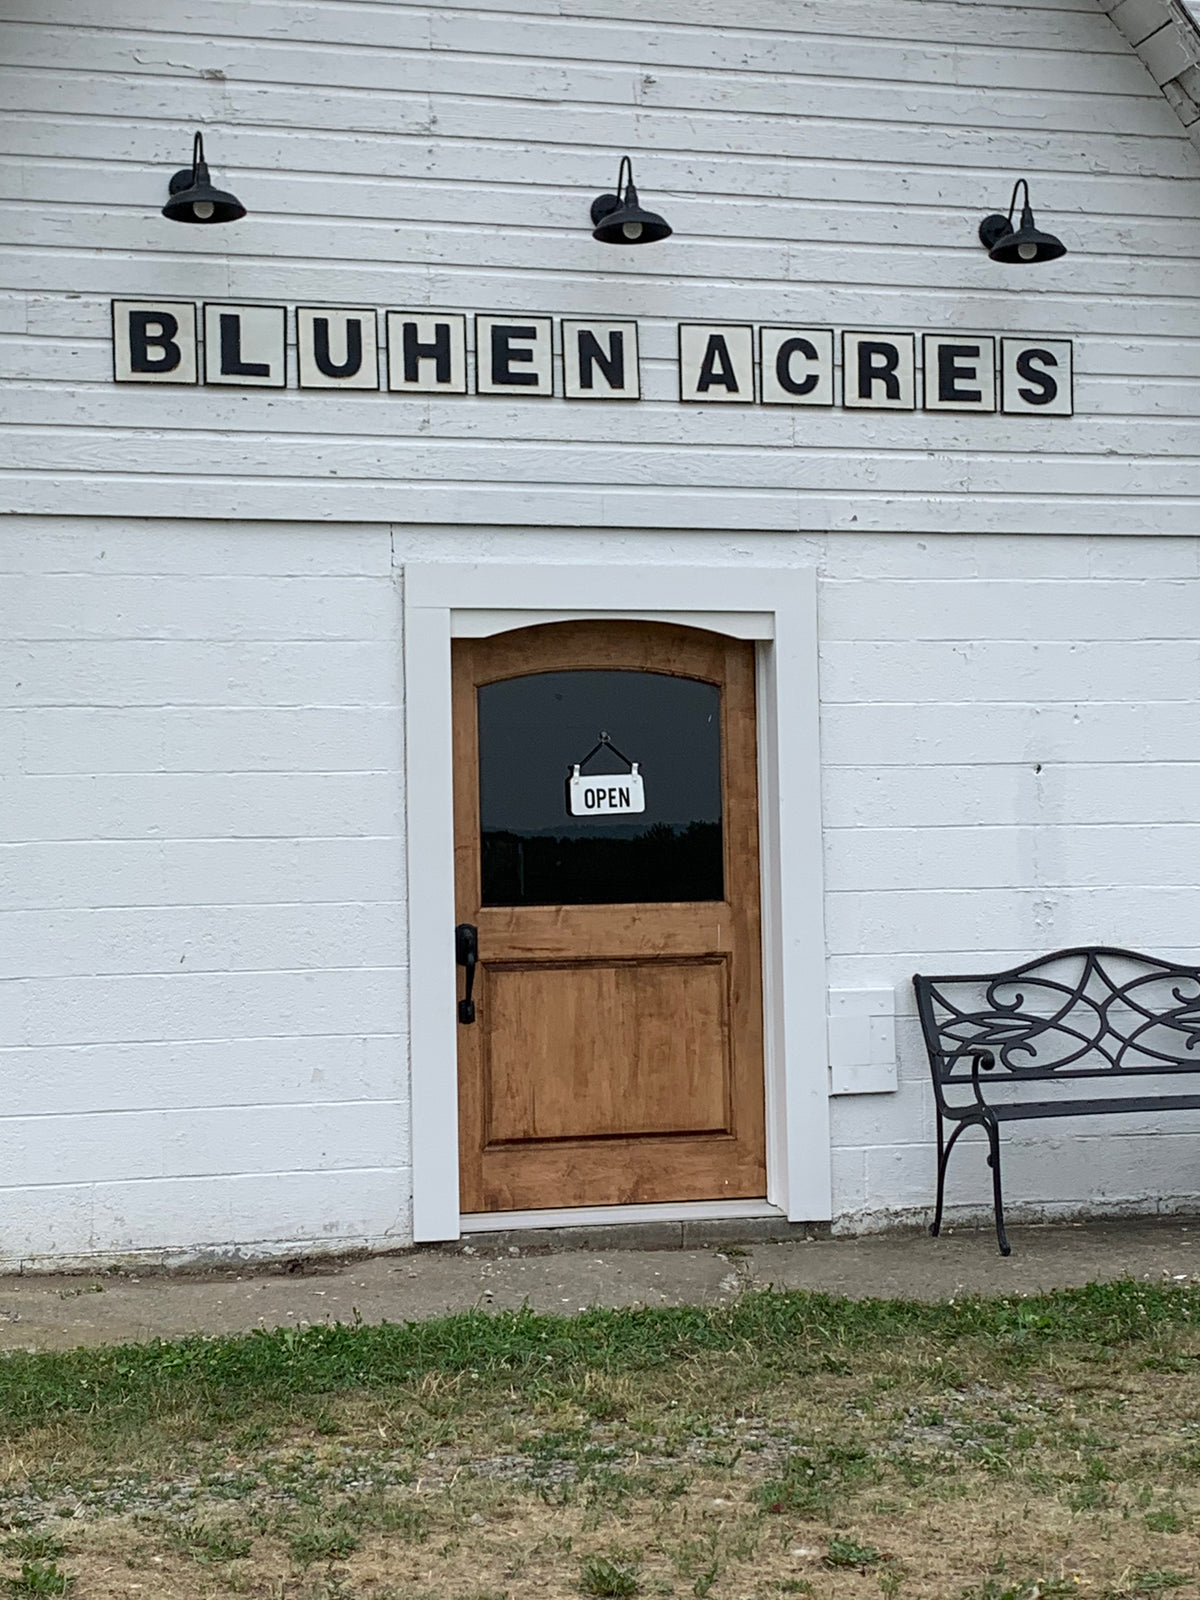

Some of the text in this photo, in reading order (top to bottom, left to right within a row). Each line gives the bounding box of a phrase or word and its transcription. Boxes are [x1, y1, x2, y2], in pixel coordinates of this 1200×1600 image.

[128, 310, 1060, 406] BLUHEN ACRES
[583, 787, 631, 809] OPEN
